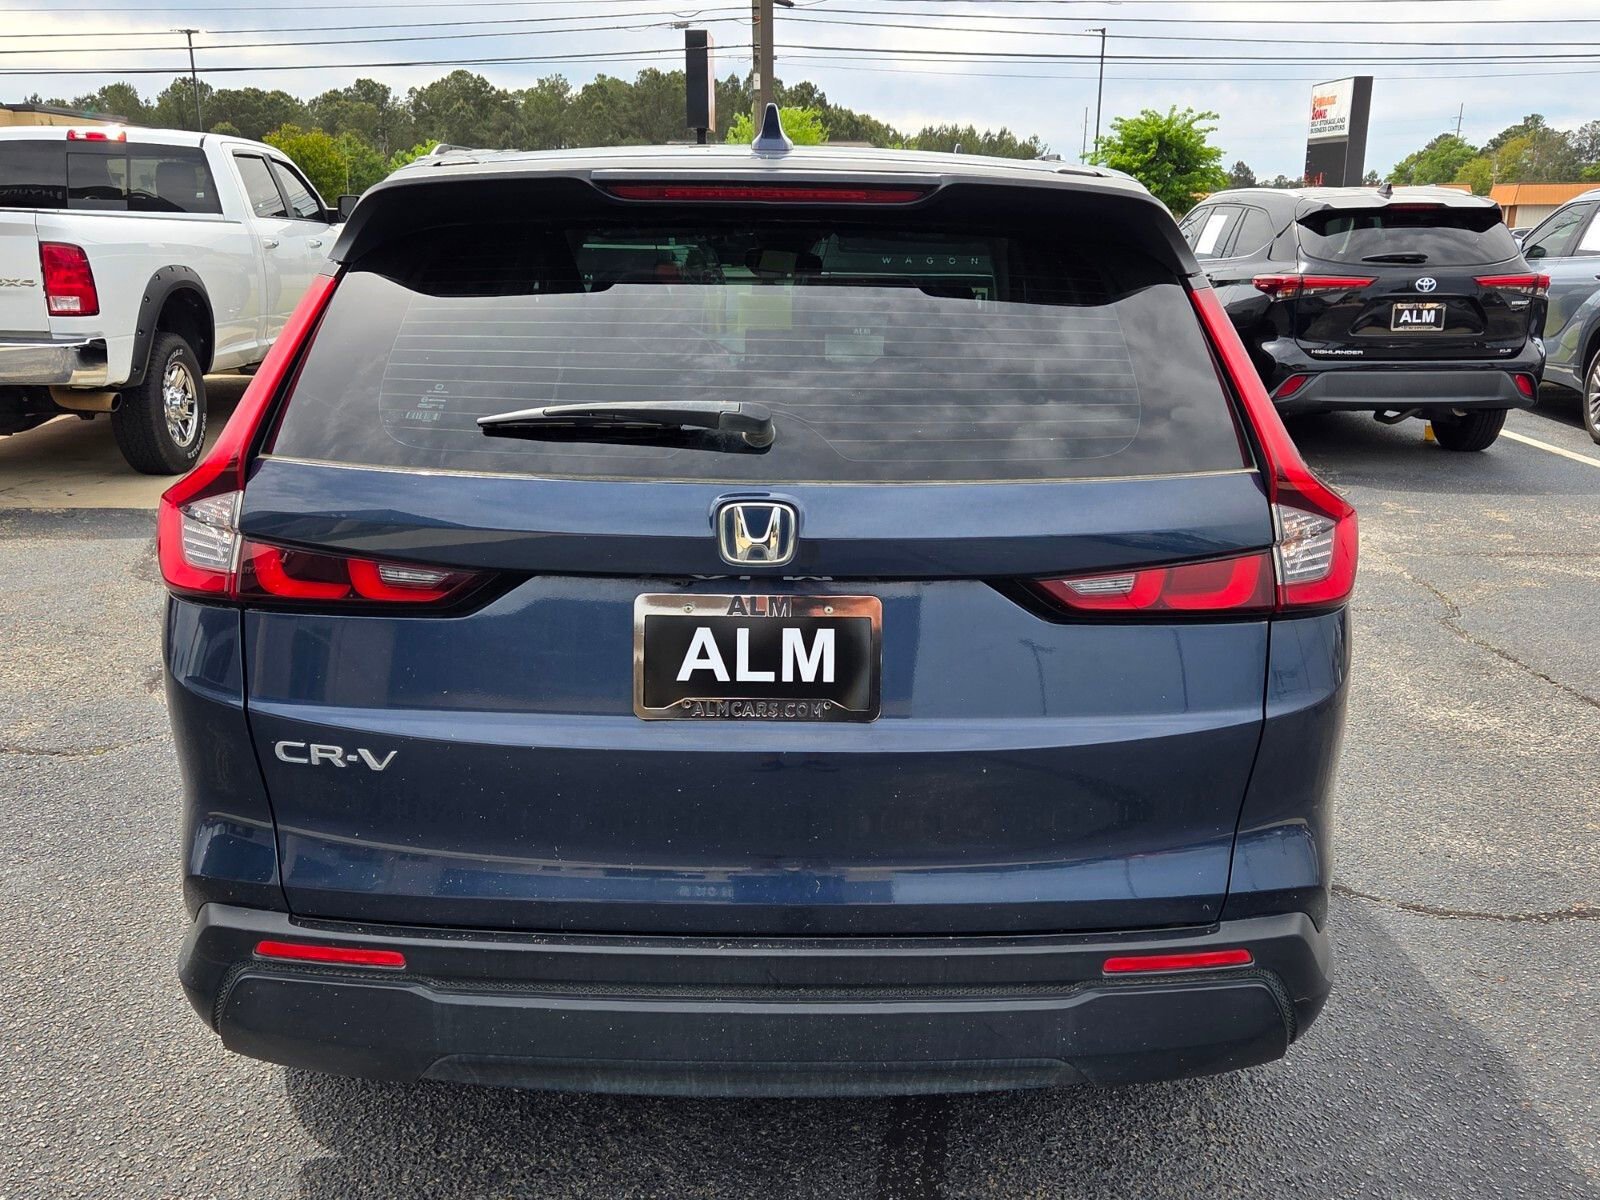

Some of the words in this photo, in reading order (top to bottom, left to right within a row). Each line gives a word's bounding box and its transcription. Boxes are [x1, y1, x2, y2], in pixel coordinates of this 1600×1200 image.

[1310, 126, 1327, 134] BUSINESS
[1319, 118, 1336, 126] STORAGE
[1399, 309, 1436, 323] ALM
[726, 595, 792, 618] ALM
[676, 626, 835, 683] ALM
[691, 700, 824, 719] ALMCARS.COM
[274, 740, 398, 771] CR-V
